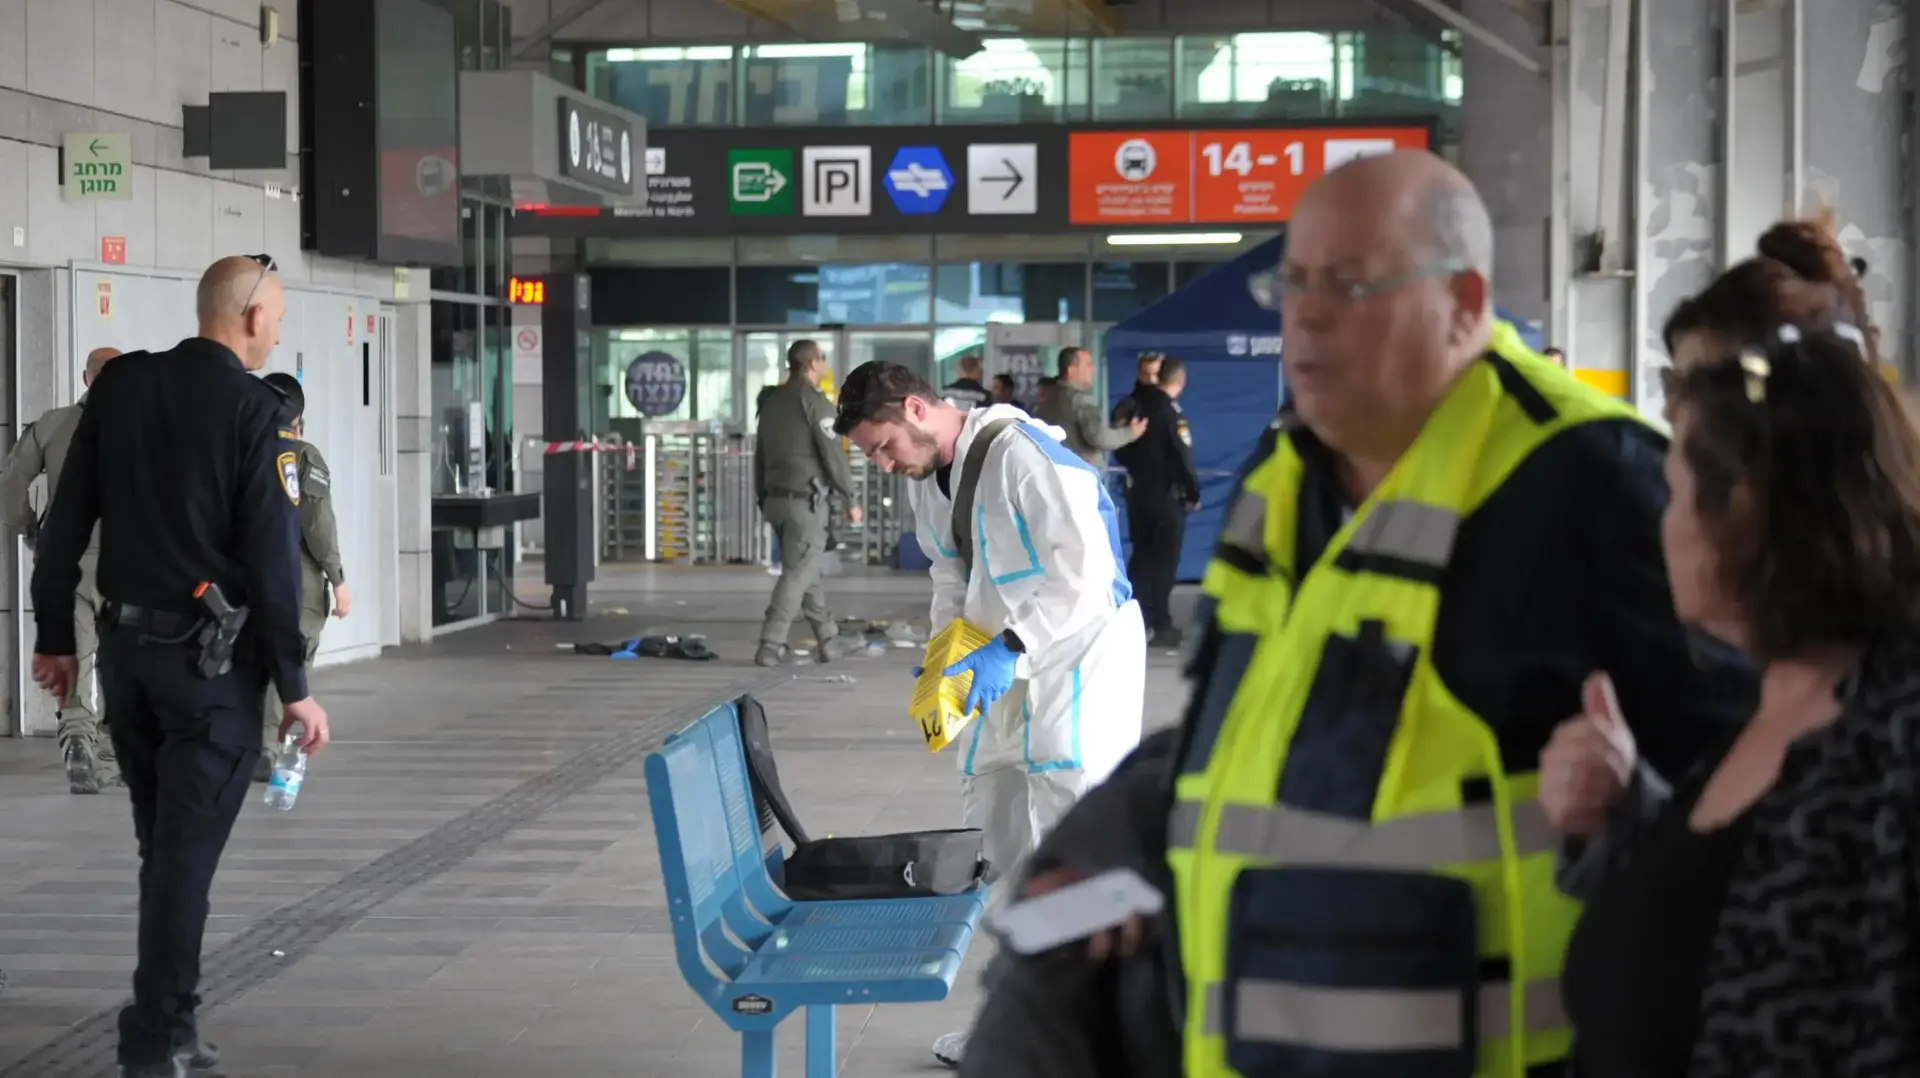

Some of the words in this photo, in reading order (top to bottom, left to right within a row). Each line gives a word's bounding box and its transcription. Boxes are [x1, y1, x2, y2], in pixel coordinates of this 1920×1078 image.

[73, 162, 123, 176] מרחב
[1202, 142, 1304, 176] 14-1
[80, 178, 117, 195] מוגן
[921, 707, 943, 743] 21
